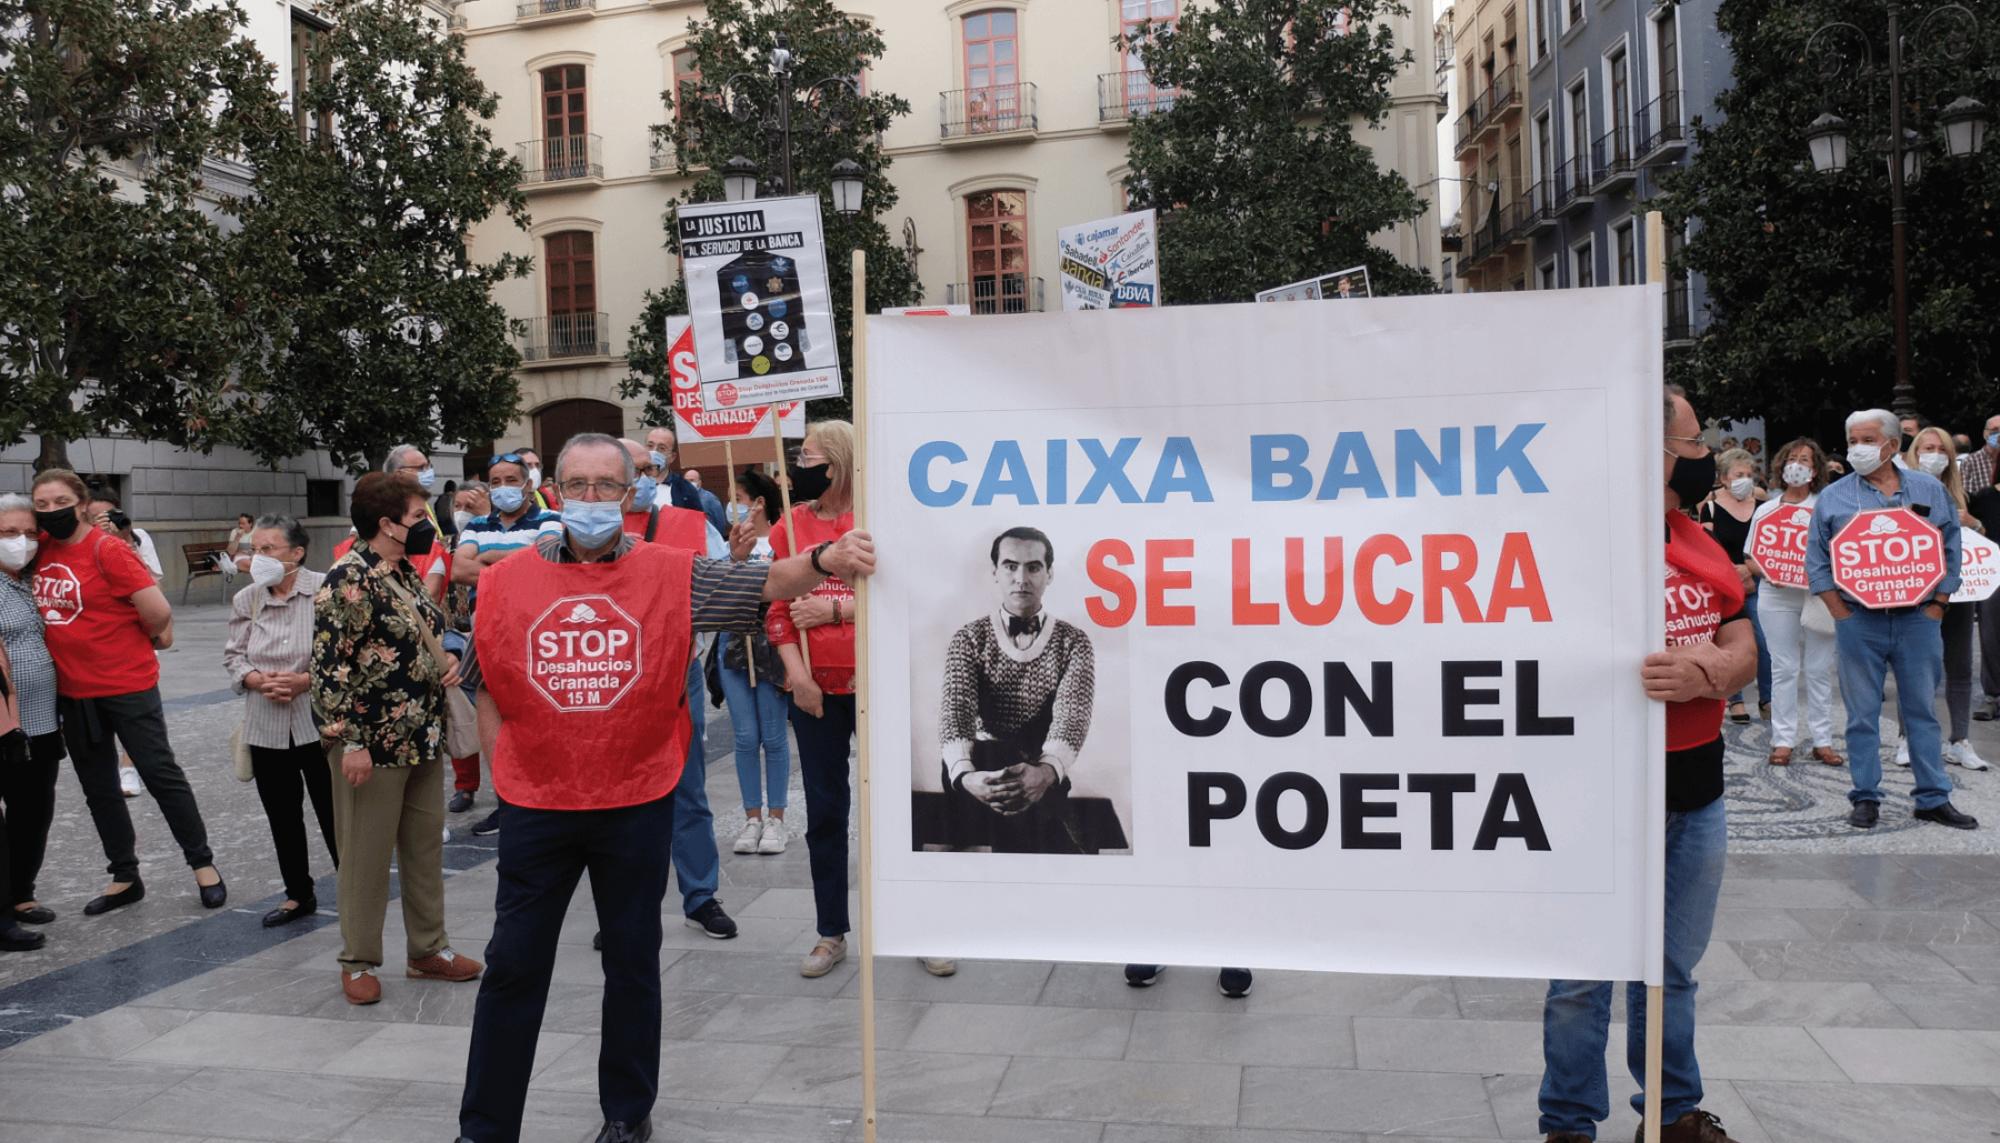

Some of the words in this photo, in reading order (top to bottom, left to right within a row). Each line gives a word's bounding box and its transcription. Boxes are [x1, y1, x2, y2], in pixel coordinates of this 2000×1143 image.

[685, 220, 696, 231] LA
[698, 213, 762, 236] JUSTICIA
[700, 240, 741, 254] SERVICIO
[743, 240, 754, 251] DE
[756, 239, 767, 249] LA
[768, 234, 801, 248] BANCA
[1086, 226, 1120, 243] cajamar
[1107, 219, 1146, 255] Santander
[1117, 285, 1151, 302] BBVA
[692, 408, 757, 426] GRANADA
[907, 436, 1215, 508] CAIXA
[1250, 422, 1550, 502] BANK
[1757, 545, 1806, 562] Desahu
[1838, 534, 1934, 566] STOP
[1084, 537, 1197, 628] SE
[1231, 532, 1554, 627] LUCRA
[1779, 571, 1791, 581] 15
[1793, 573, 1803, 583] M
[1841, 561, 1936, 580] Desahucios
[32, 574, 74, 599] STOP
[1855, 576, 1925, 593] Granada
[1665, 581, 1714, 614] TOP
[1876, 591, 1891, 602] 15
[1895, 590, 1907, 600] M
[538, 629, 629, 658] STOP
[537, 658, 632, 675] Desahucios
[548, 674, 620, 691] Granada
[568, 692, 583, 704] 15
[588, 691, 600, 704] M
[1164, 659, 1395, 738] CON
[1441, 659, 1575, 738] EL
[1186, 771, 1552, 853] POETA
